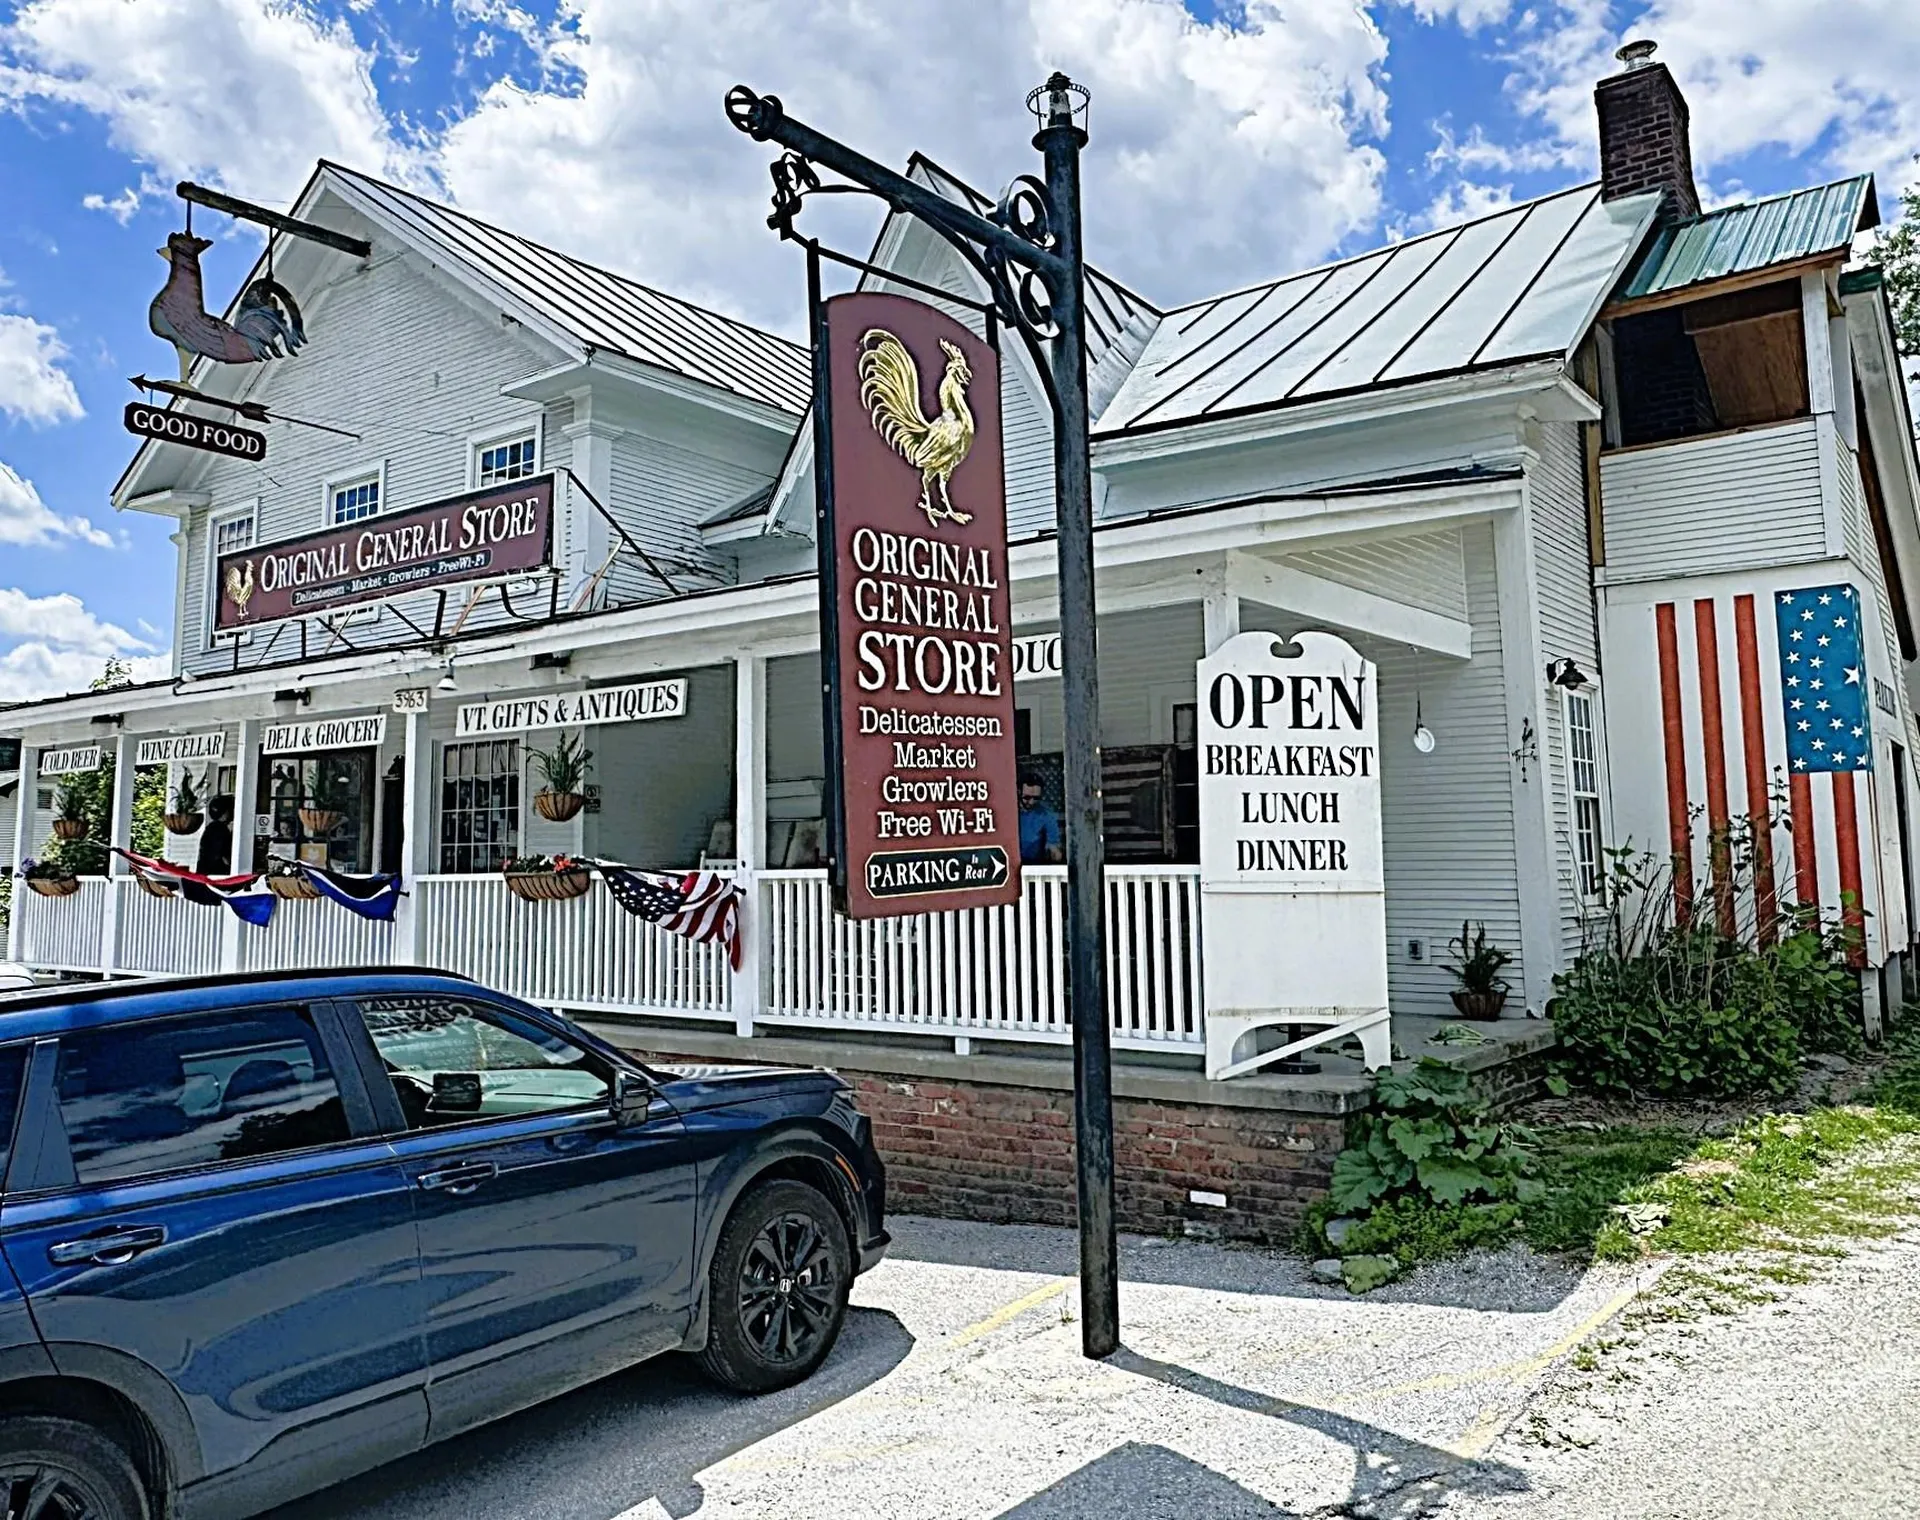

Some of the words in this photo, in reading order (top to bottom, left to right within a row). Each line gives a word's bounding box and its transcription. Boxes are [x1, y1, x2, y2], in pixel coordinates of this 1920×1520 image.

[133, 409, 198, 440] GOOD
[202, 425, 260, 454] FOOD
[260, 543, 350, 592] ORIGINAL
[356, 518, 452, 572] GENERAL
[459, 497, 539, 550] STORE
[853, 528, 998, 589] ORIGINAL
[351, 575, 382, 592] Market
[388, 566, 430, 584] Growlers
[855, 578, 999, 634] GENERAL
[858, 630, 1001, 696] STORE
[461, 705, 488, 731] VT.
[491, 699, 549, 729] GIFTS
[554, 699, 568, 723] &
[573, 684, 680, 721] ANTIQUES
[1209, 672, 1366, 730] OPEN
[267, 726, 299, 751] DELI
[301, 728, 313, 748] &
[315, 717, 384, 746] GROCERY
[859, 706, 1003, 737] Delicatessen
[44, 751, 69, 772] COLD
[70, 749, 98, 769] BEER
[140, 738, 173, 761] WINE
[174, 733, 222, 759] CELLAR
[893, 741, 977, 768] Market
[1205, 744, 1374, 777] BREAKFAST
[882, 776, 988, 803] Growlers
[877, 811, 932, 838] Free
[936, 807, 996, 835] Wi-Fi
[1242, 791, 1341, 824] LUNCH
[965, 864, 988, 880] Rear
[971, 854, 979, 864] In
[1236, 839, 1348, 872] DINNER
[869, 858, 960, 889] PARKING
